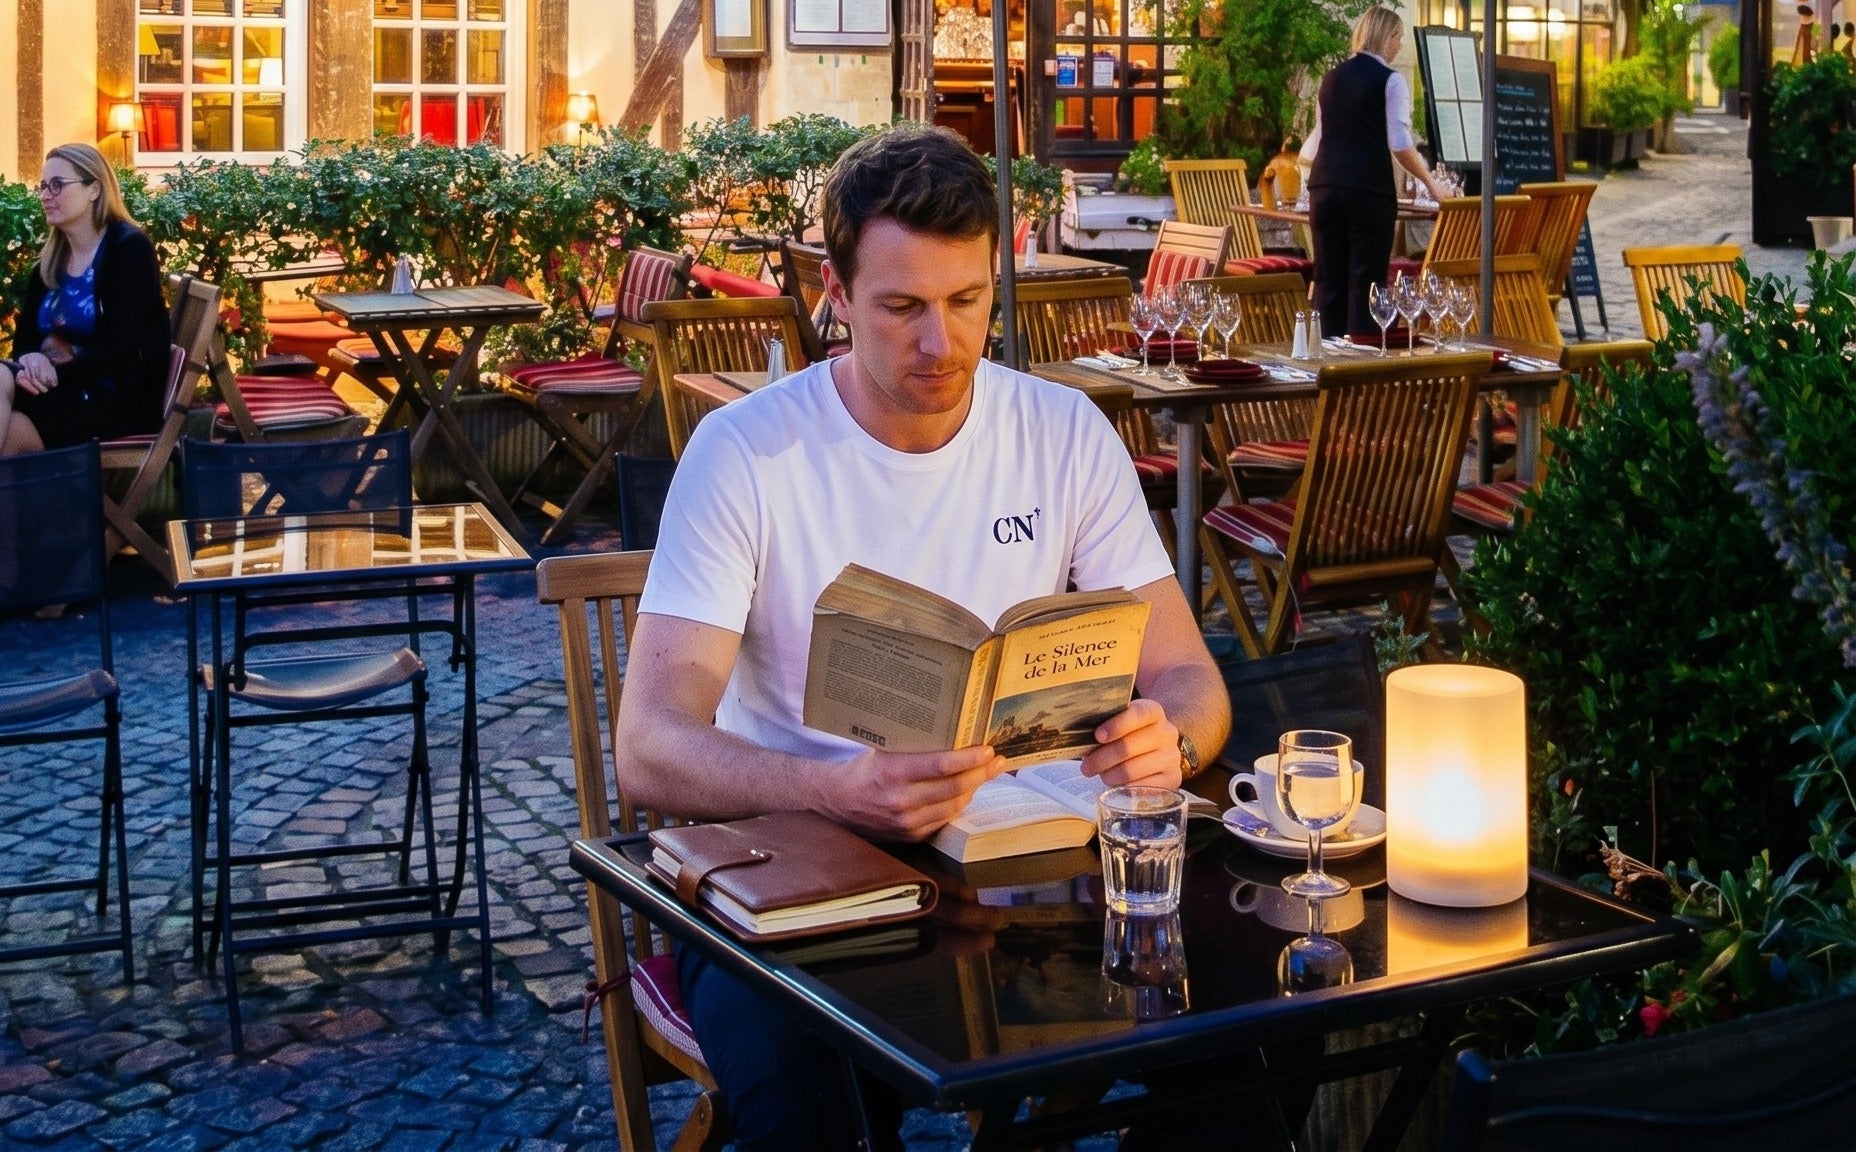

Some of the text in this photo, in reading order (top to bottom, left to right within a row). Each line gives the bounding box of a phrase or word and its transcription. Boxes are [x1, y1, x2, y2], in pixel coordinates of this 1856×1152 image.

[1024, 640, 1117, 666] Le Silence
[1024, 654, 1111, 680] de la Mer
